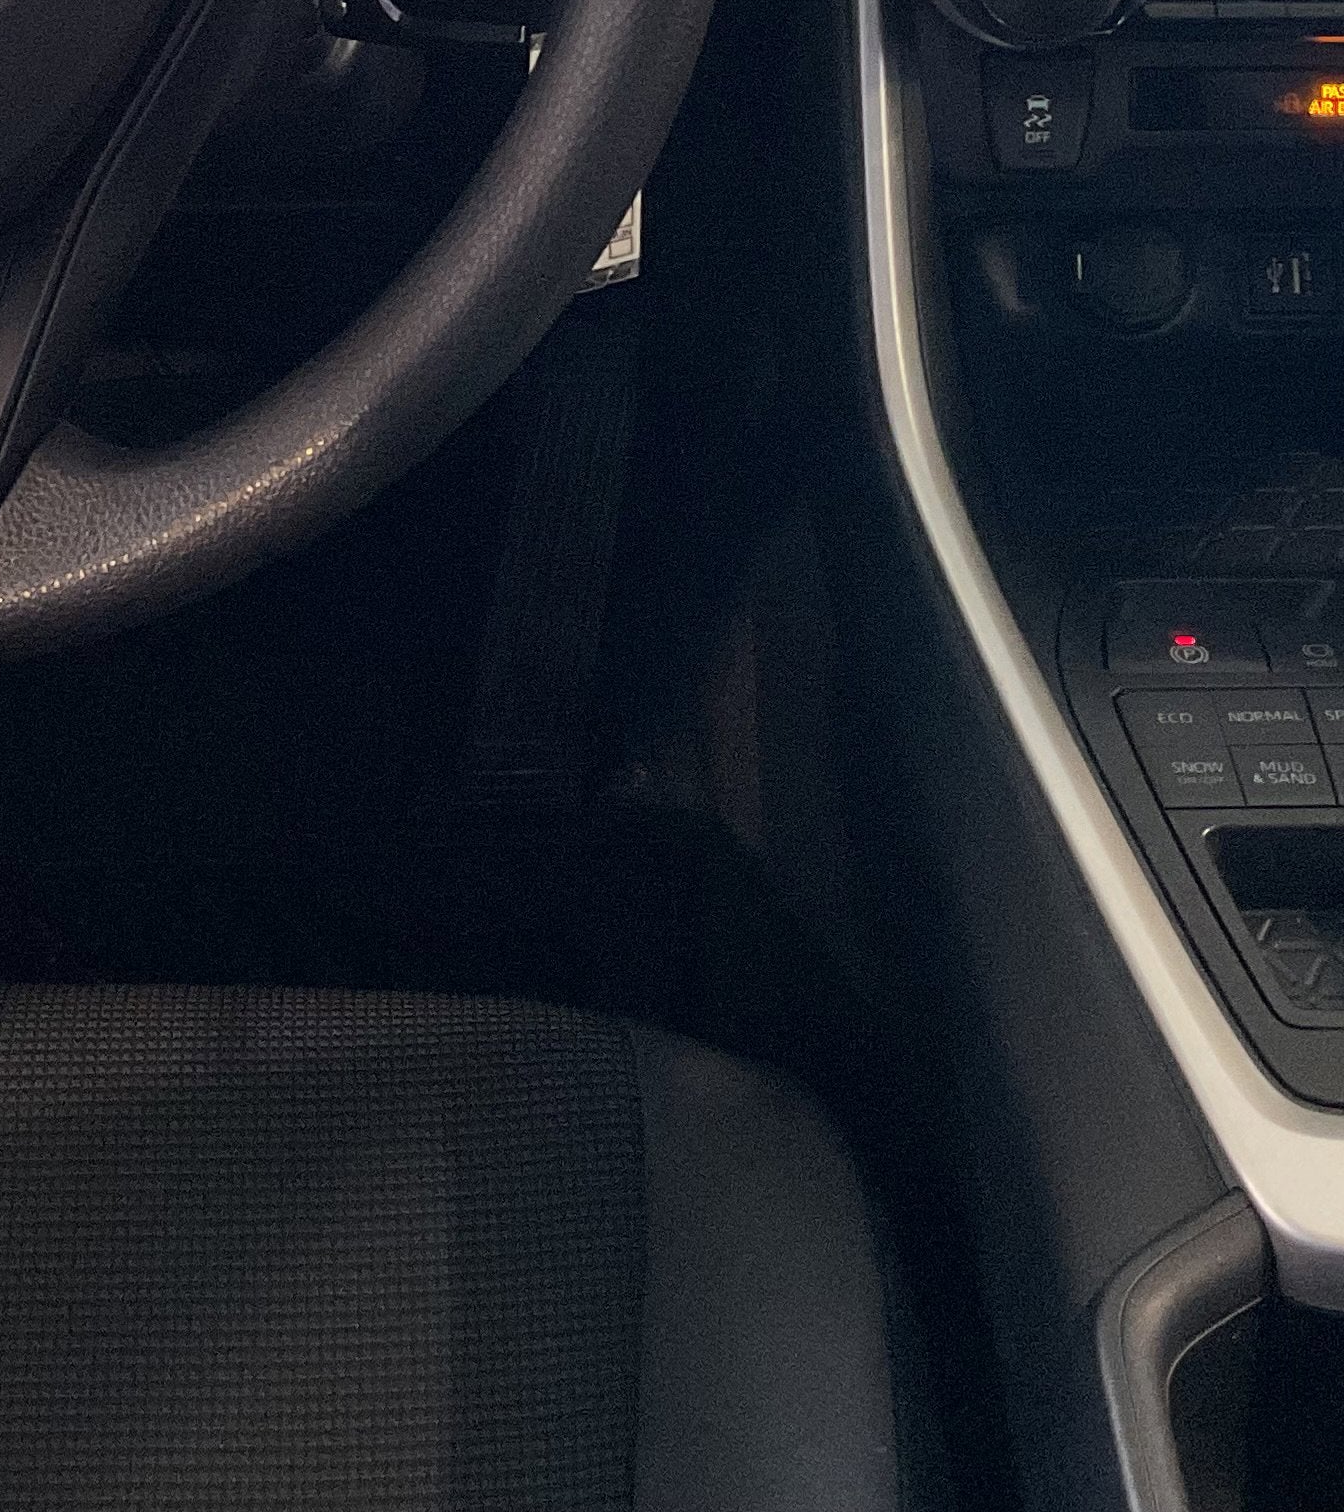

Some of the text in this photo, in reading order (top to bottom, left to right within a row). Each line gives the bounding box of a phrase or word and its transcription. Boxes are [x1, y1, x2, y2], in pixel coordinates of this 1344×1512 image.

[1308, 99, 1334, 115] AIR
[1024, 131, 1051, 144] OFF
[1227, 710, 1305, 723] NORMAL
[1170, 761, 1224, 774] SNOW
[1259, 761, 1305, 773] MUD
[1267, 773, 1317, 785] SAND
